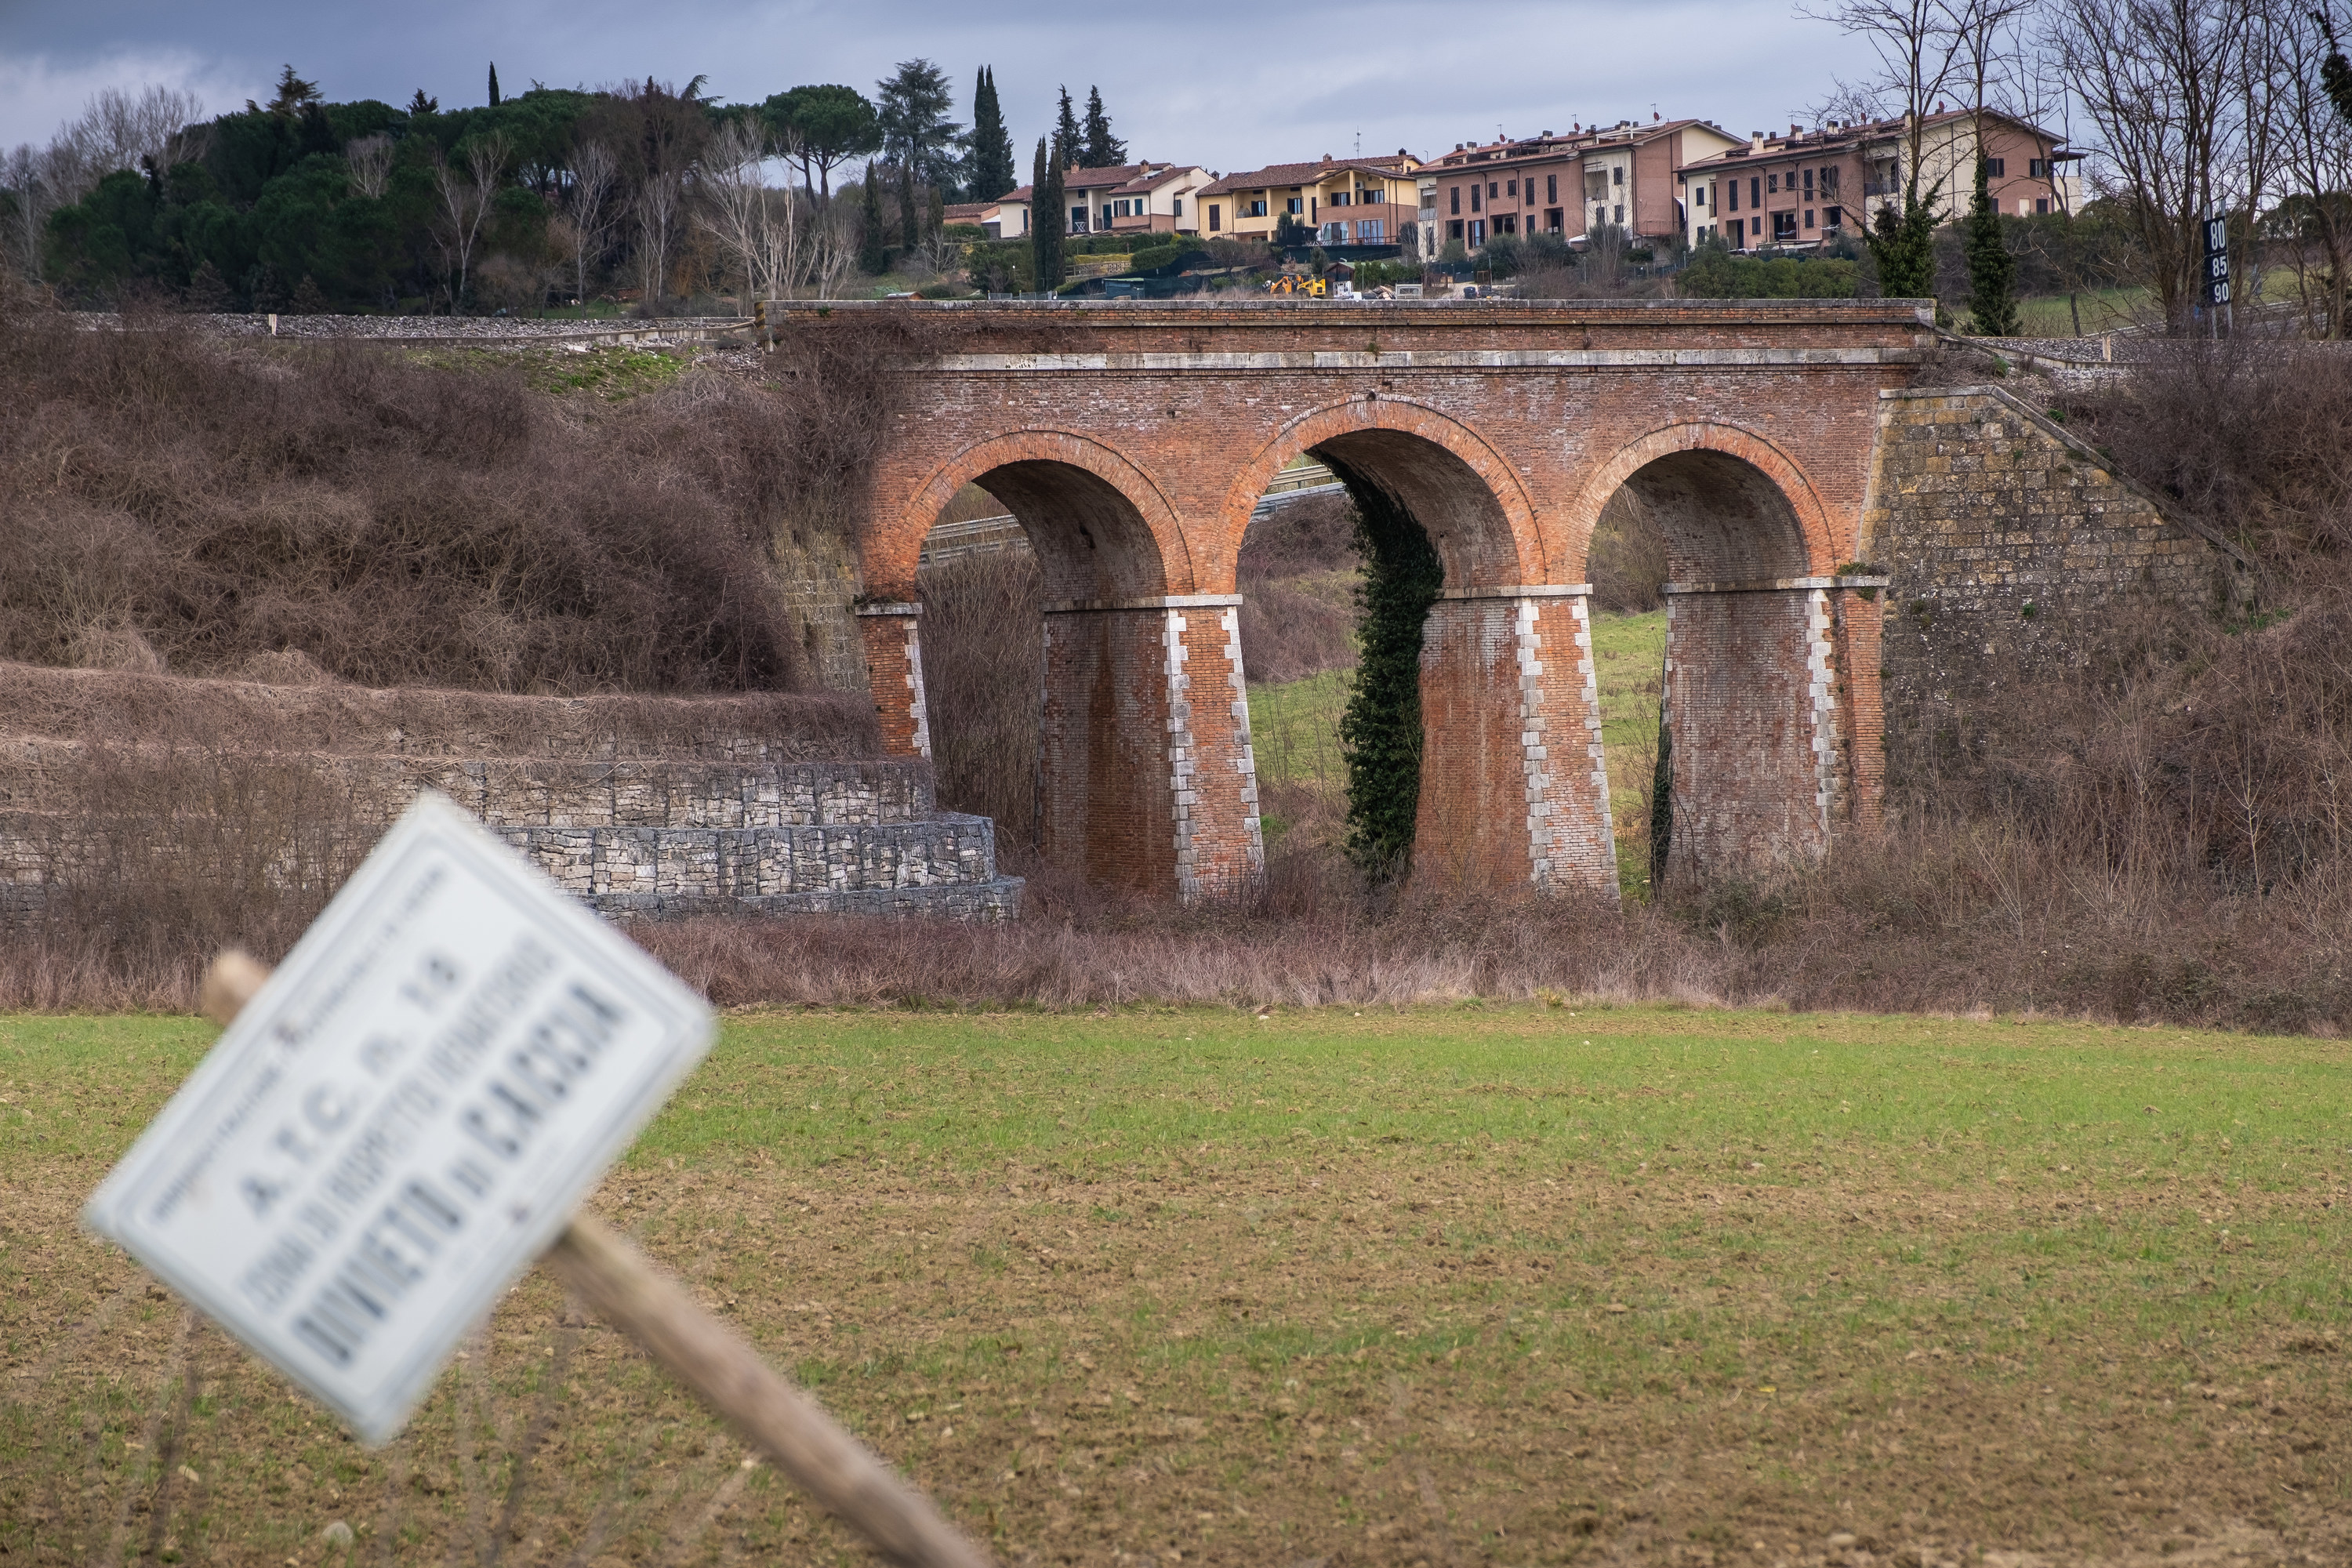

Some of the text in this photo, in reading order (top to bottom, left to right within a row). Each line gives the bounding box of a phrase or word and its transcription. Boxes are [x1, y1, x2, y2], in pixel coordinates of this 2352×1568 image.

[2210, 220, 2226, 251] 80
[2212, 256, 2227, 278] 85
[2214, 282, 2229, 303] 90
[287, 1170, 470, 1375] DIVIETO
[453, 968, 633, 1168] CACCIA
